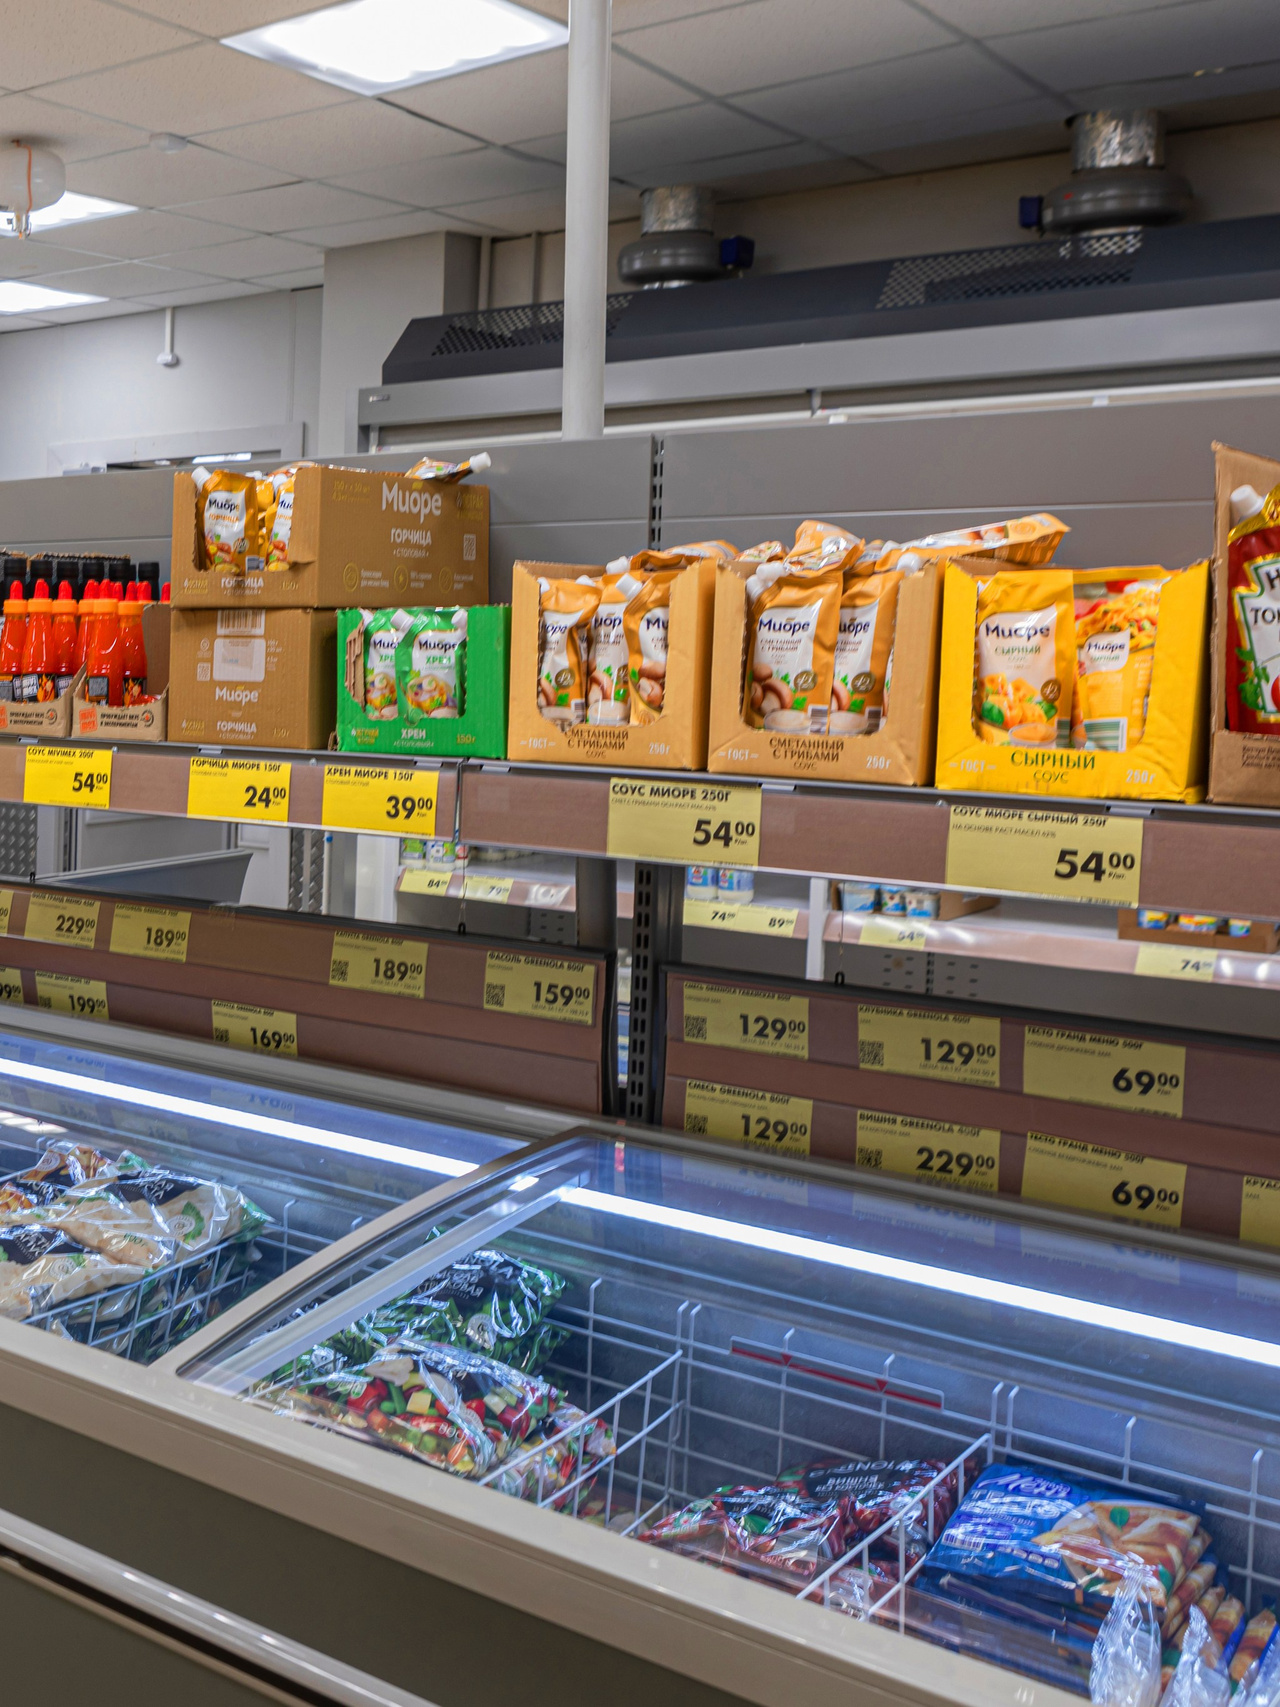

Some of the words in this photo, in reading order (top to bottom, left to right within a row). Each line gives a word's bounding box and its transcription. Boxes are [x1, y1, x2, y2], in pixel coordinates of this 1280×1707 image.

[381, 481, 442, 524] Миоре
[390, 527, 432, 547] ГОРЧИЦА
[758, 618, 810, 637] Миоре
[839, 620, 870, 637] иоре
[985, 623, 1050, 641] Миоре
[379, 654, 395, 663] ХРЕ
[994, 645, 1041, 656] СЫРНЫЙ
[215, 685, 259, 706] Миоре
[216, 720, 257, 733] ГОРЧИЦА
[401, 728, 426, 739] ХРЕН
[577, 740, 626, 750] ГРИБАМИ
[770, 736, 844, 751] СМЕТАННЫЙ
[27, 748, 46, 756] СОУС
[47, 750, 76, 758] MIVIMEX
[727, 748, 750, 761] ГОСТ
[784, 750, 840, 763] ГРИБАМИ
[1011, 750, 1096, 770] СЫРНЫЙ
[191, 759, 230, 769] ГОРЧИЦА
[231, 761, 260, 772] МИОРЕ
[264, 762, 282, 772] 150Г
[326, 766, 351, 777] ХРЕН
[354, 769, 389, 780] МИОРЕ
[393, 770, 415, 781] 150Г
[794, 761, 818, 771] СОУС
[959, 759, 986, 772] ГОСТ
[1033, 770, 1069, 784] СОУС
[612, 783, 645, 796] СОУС
[649, 786, 697, 800] МИОРЕ
[701, 789, 731, 802] 250Г
[953, 806, 982, 817] СОУС
[985, 808, 1023, 820] МИОРЕ
[1027, 812, 1079, 825] СЫРНЫЙ
[1082, 816, 1109, 828] 250Г
[489, 952, 521, 963] ФАСОЛЬ
[524, 956, 565, 969] GREENOLA
[859, 1004, 904, 1016] КЛУБНИКА
[906, 1010, 950, 1022] GREENOLA
[1027, 1026, 1054, 1038] ТЕСТО
[1055, 1030, 1087, 1043] ГРАНД
[1089, 1035, 1120, 1047] МЕНЮ
[688, 1081, 717, 1092] СМЕСЬ
[719, 1086, 767, 1101] GREENOLA
[859, 1111, 897, 1125] ВИШНЯ
[900, 1118, 955, 1134] GREENOLA
[1029, 1132, 1056, 1145] ТЕСТО
[1058, 1138, 1088, 1153] ГРАНД
[1091, 1145, 1121, 1159] МЕНЮ
